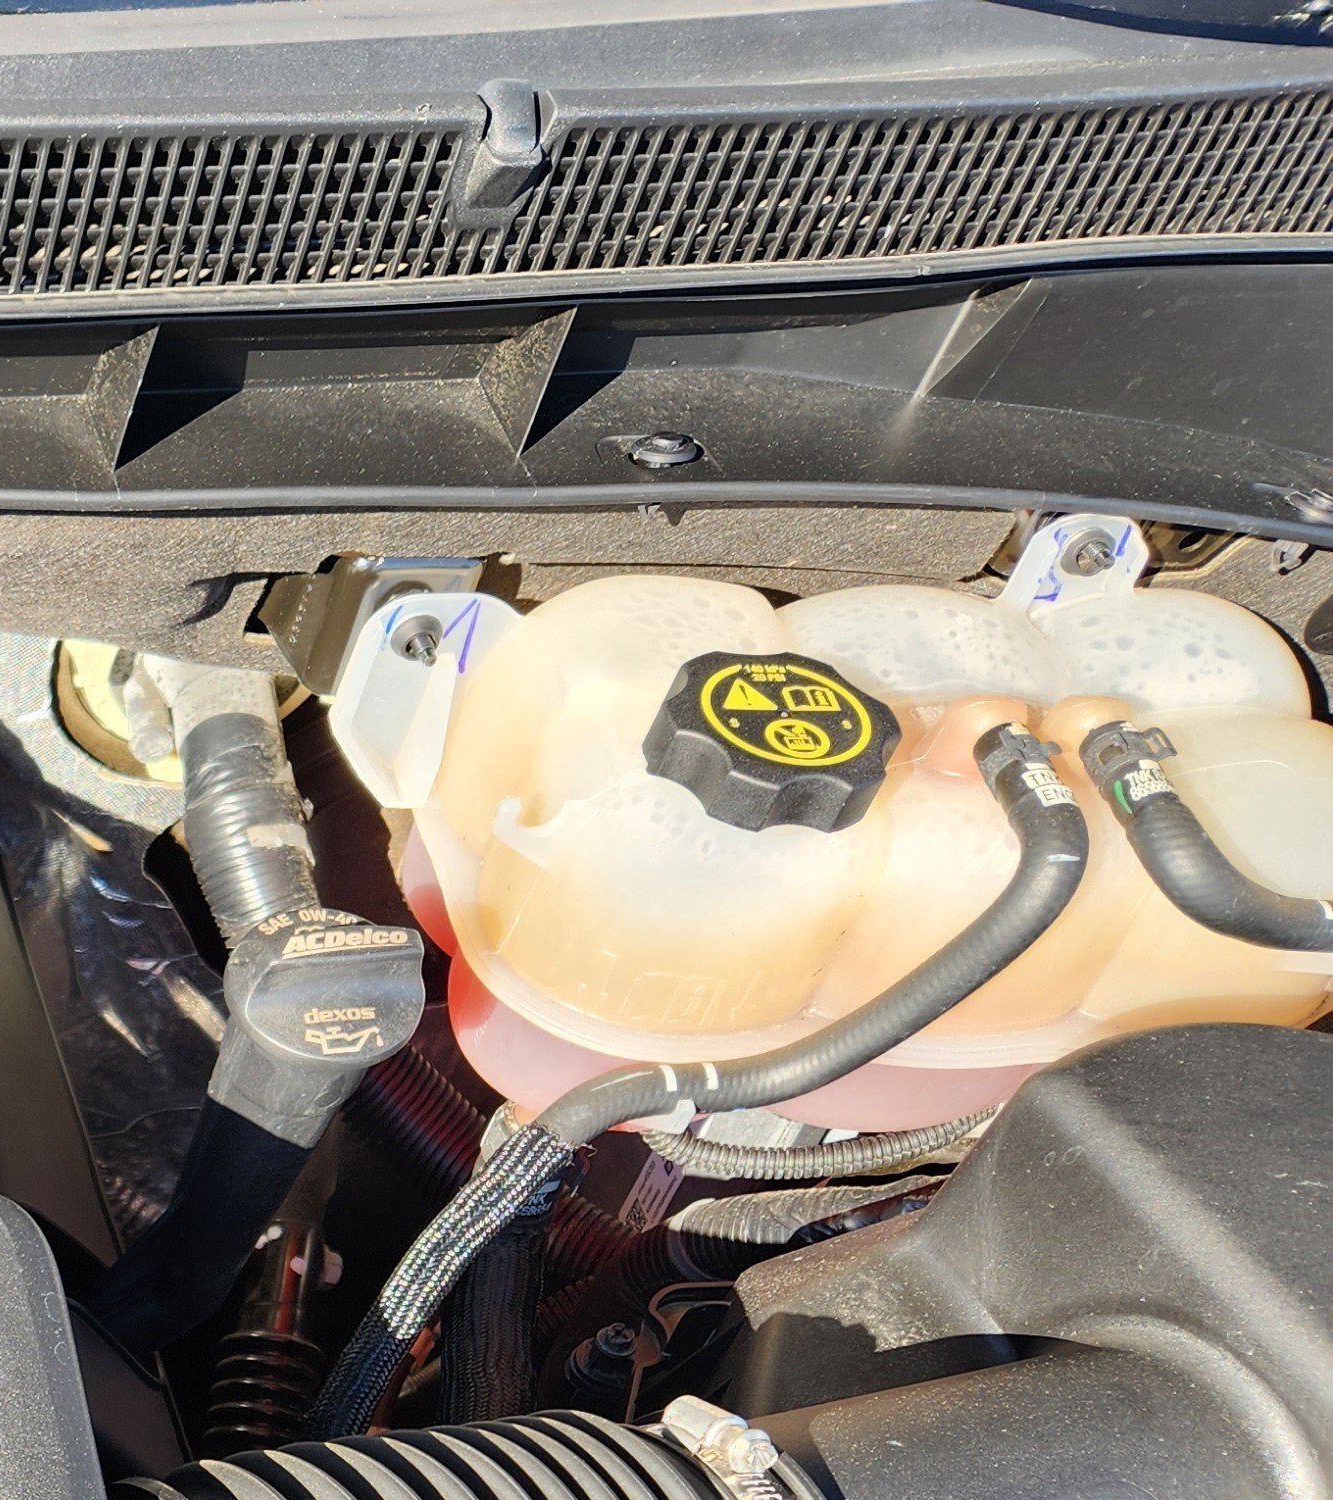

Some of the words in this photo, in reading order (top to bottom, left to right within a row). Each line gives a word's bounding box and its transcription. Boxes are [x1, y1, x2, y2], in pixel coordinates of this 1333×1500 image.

[258, 913, 293, 936] SAE
[283, 928, 408, 955] ACDelco
[303, 1007, 376, 1025] dexos
